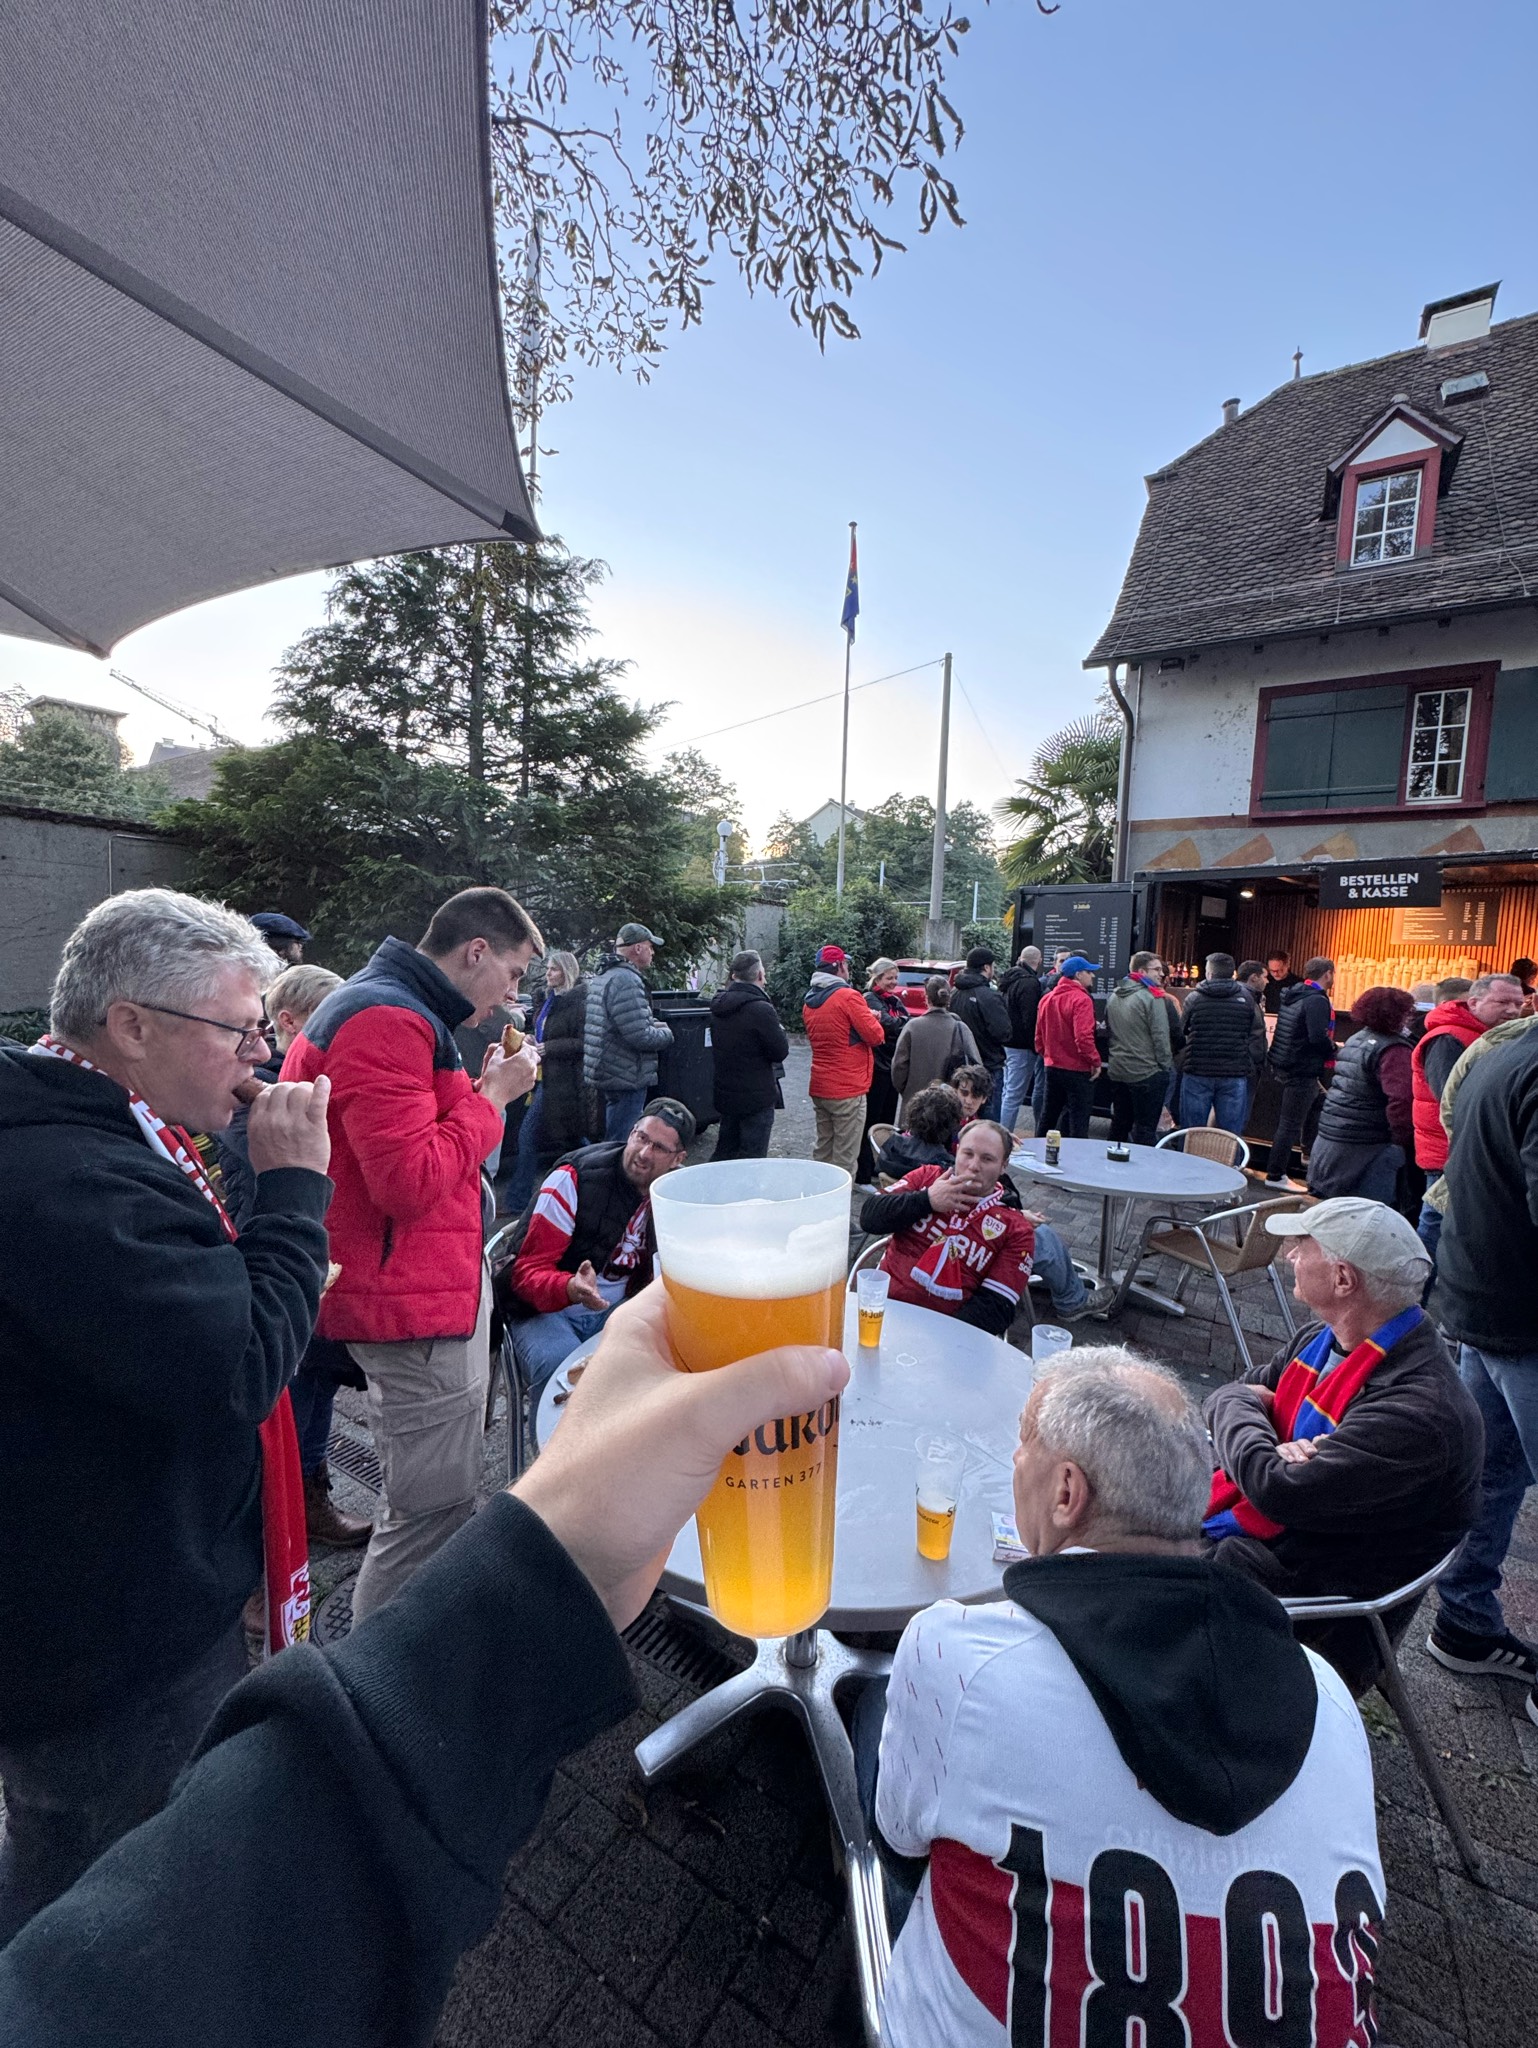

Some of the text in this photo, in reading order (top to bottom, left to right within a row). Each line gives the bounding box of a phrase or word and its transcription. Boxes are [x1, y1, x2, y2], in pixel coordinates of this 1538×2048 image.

[1339, 872, 1419, 887] BESTELLEN
[1348, 886, 1408, 899] & KASSE
[725, 1461, 822, 1490] GARTEN 377
